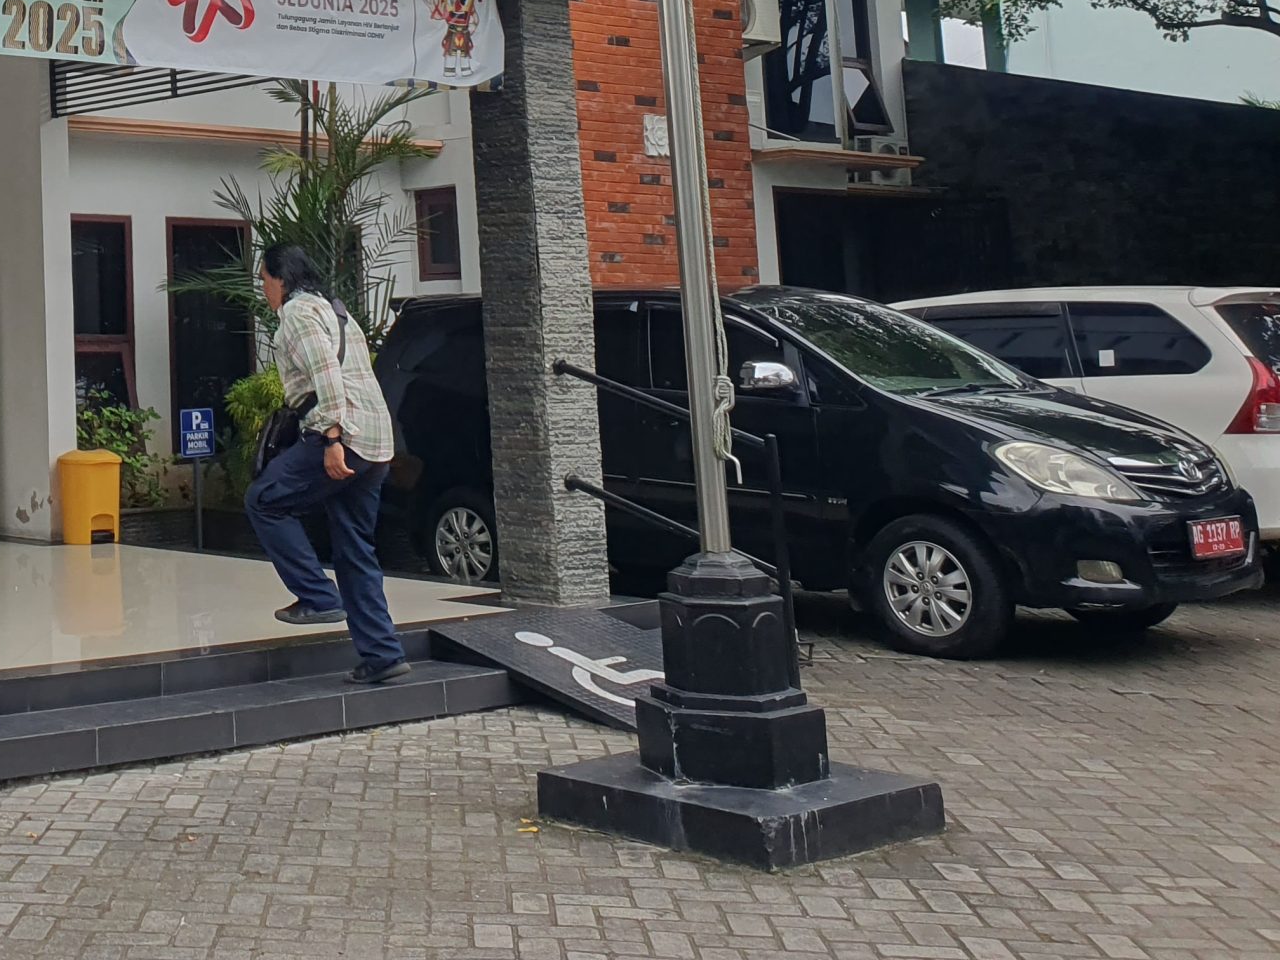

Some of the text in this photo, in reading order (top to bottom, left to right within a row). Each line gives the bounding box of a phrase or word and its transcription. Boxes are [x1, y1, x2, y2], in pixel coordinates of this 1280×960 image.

[278, 12, 317, 24] Tulungagung
[317, 16, 337, 24] Jamin
[337, 19, 362, 27] Layanan
[308, 26, 330, 35] Stigma
[192, 411, 202, 430] P
[186, 432, 209, 441] PARKIR
[187, 440, 208, 449] MOBIL
[1192, 521, 1240, 544] AG 1137 RP
